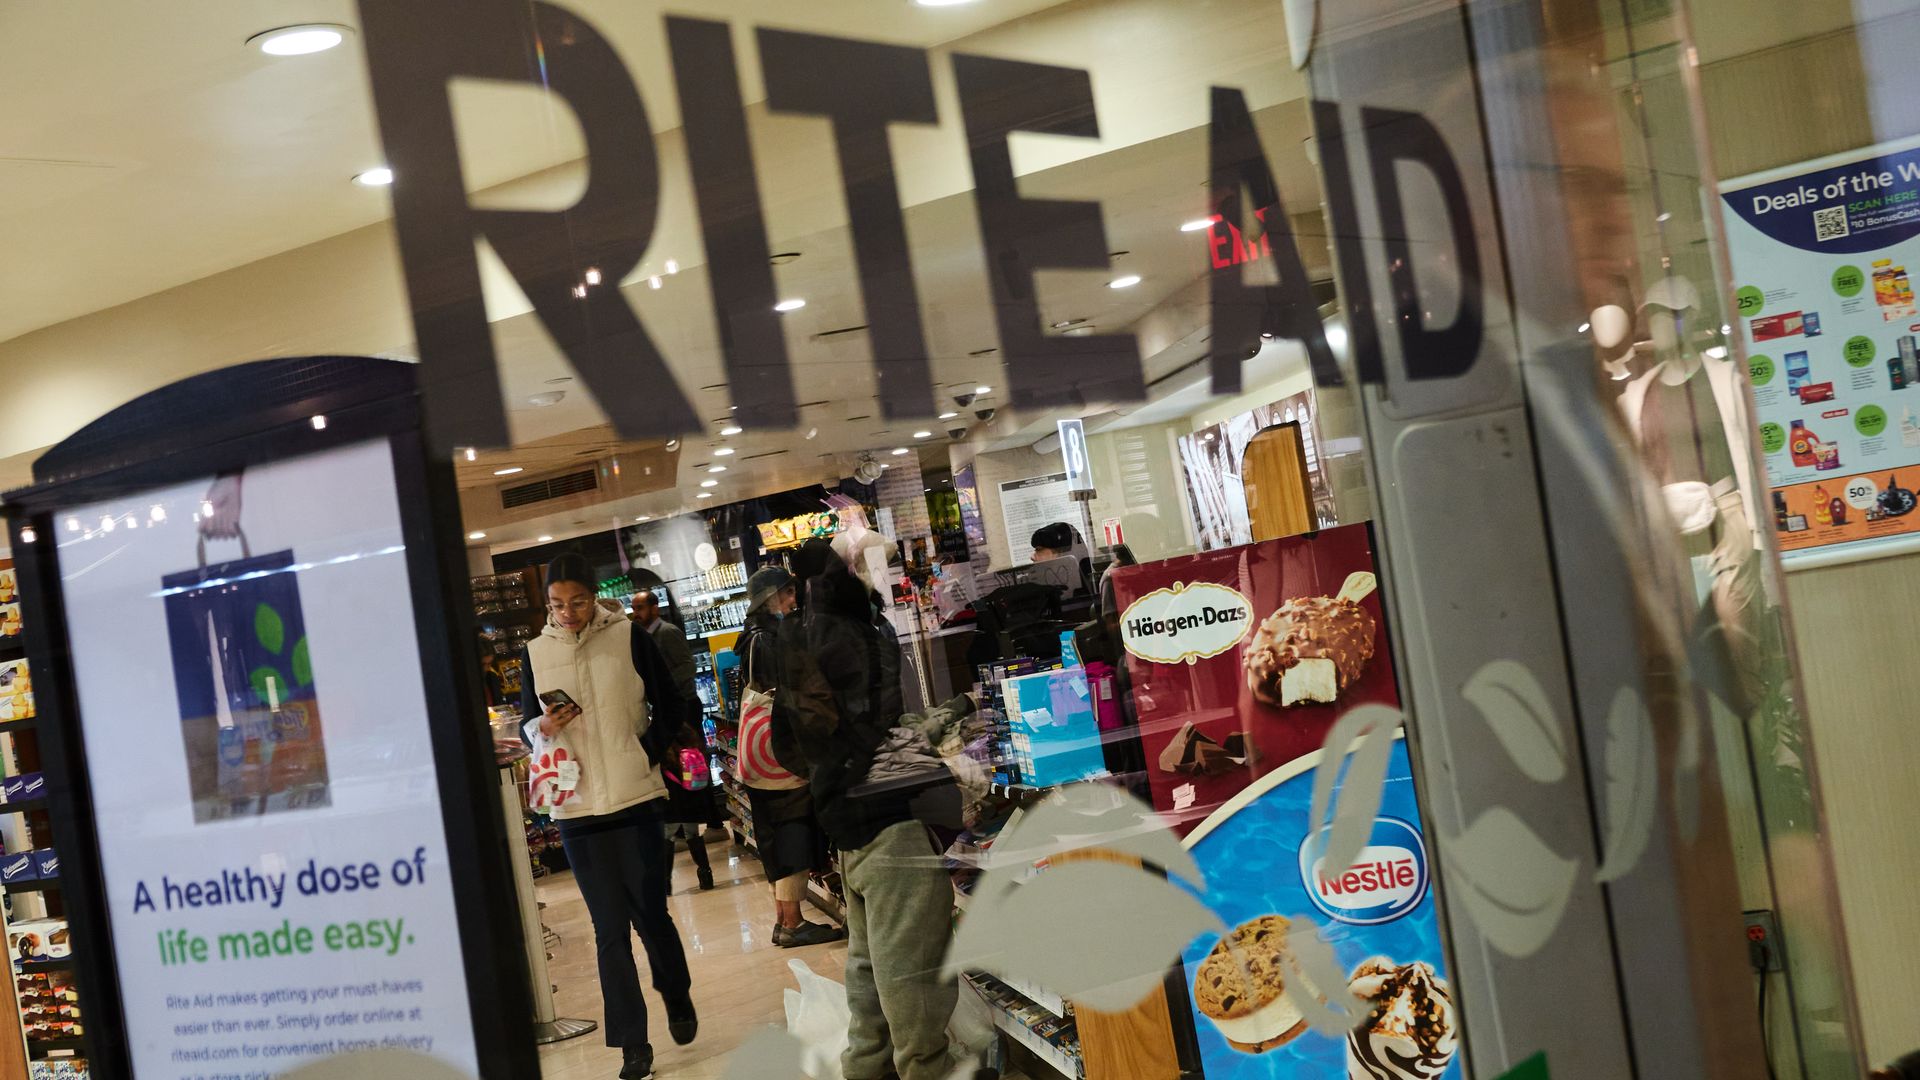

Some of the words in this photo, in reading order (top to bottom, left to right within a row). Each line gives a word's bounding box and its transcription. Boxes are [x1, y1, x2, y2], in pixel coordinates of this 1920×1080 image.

[1753, 184, 1819, 215] Deals
[1823, 176, 1846, 199] of
[1851, 172, 1894, 192] the
[1848, 198, 1881, 213] SCAN
[1885, 190, 1919, 205] HERE
[357, 0, 1148, 450] RITE
[1210, 86, 1483, 394] AID
[1068, 427, 1084, 473] 8
[1127, 606, 1247, 638] Häagen-Dazs
[133, 880, 156, 913] A
[162, 866, 286, 909] healthy
[297, 859, 380, 896] dose
[391, 846, 426, 887] of
[158, 930, 208, 966] life
[218, 920, 313, 961] made
[324, 918, 415, 956] easy.
[166, 994, 190, 1009] Rite
[193, 992, 214, 1008] Aid
[217, 991, 258, 1006] makes
[261, 988, 307, 1007] getting
[310, 986, 339, 1004] your
[343, 979, 423, 997] must-haves
[174, 1021, 209, 1036] easier
[212, 1019, 240, 1034] than
[276, 1012, 320, 1032] Simply
[324, 1011, 359, 1027] order
[362, 1009, 404, 1024] online
[408, 1007, 421, 1022] at
[171, 1045, 239, 1062] riteaid.com
[241, 1043, 259, 1059] for
[262, 1040, 335, 1057] convenient
[338, 1038, 378, 1054] home
[382, 1034, 433, 1053] delivery
